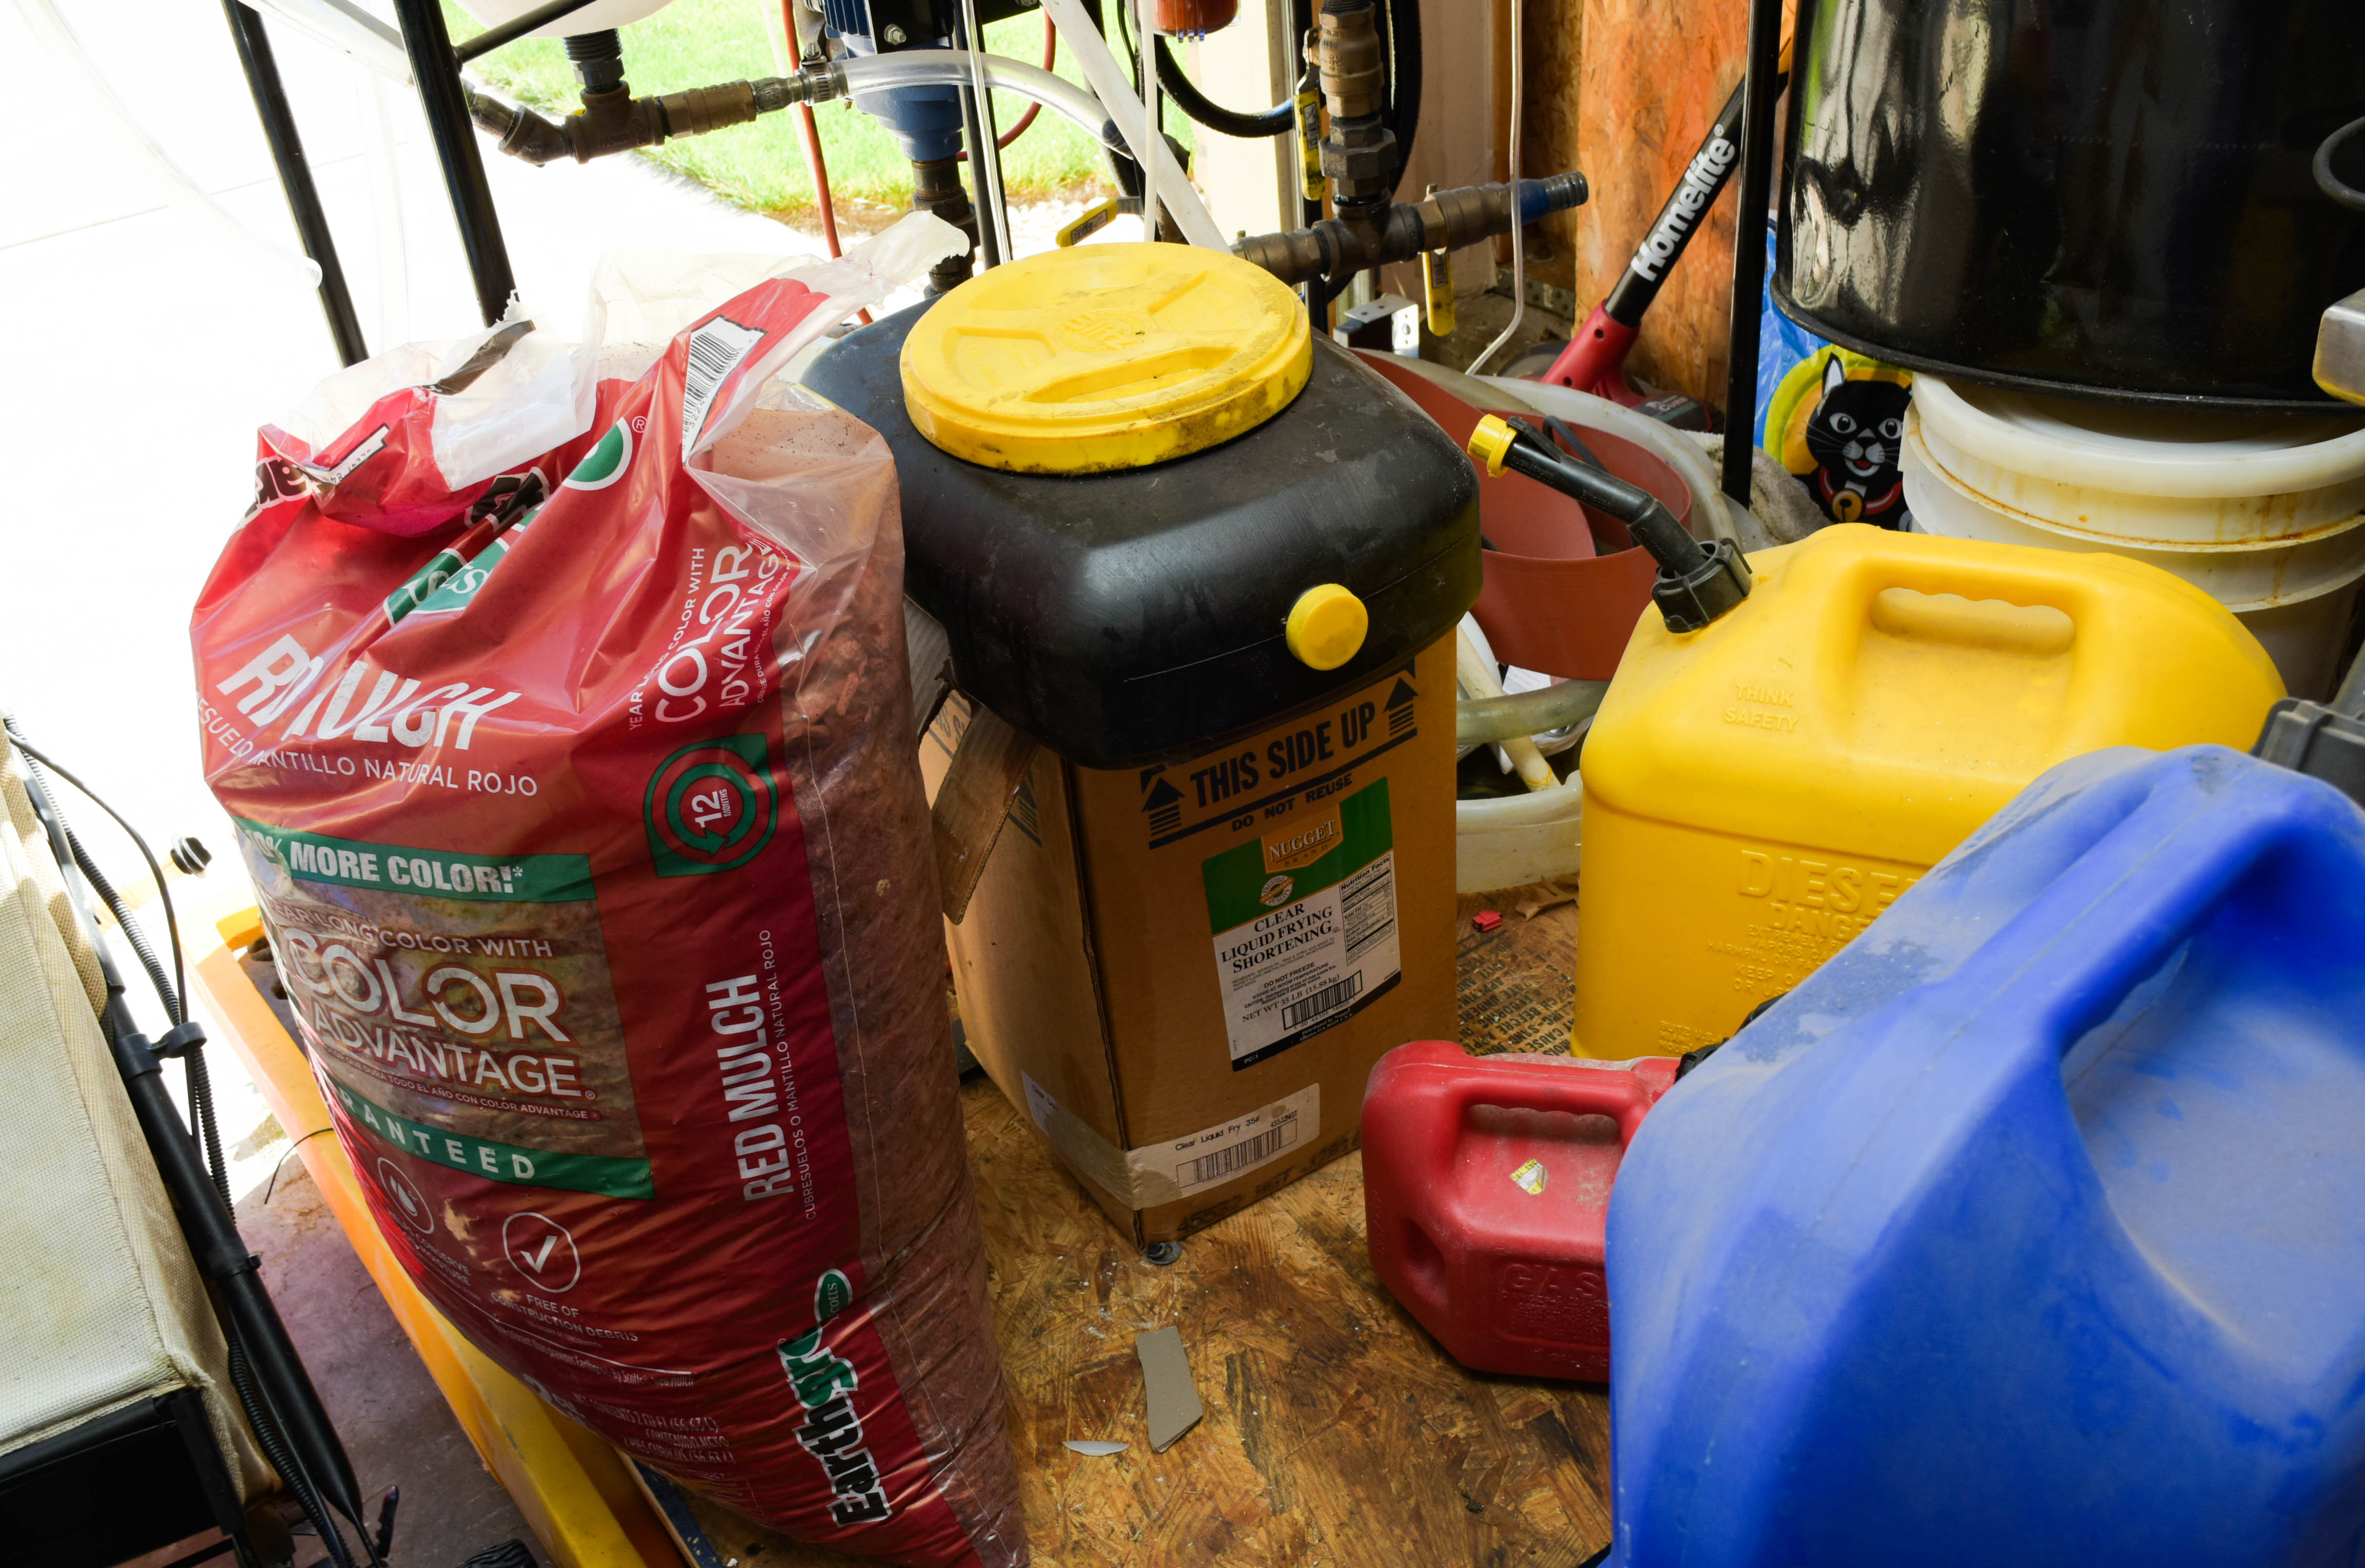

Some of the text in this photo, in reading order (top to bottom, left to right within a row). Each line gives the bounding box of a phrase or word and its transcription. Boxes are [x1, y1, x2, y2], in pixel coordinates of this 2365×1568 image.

[655, 545, 753, 722] COLOR
[762, 610, 771, 626] AÑO
[629, 548, 706, 731] YEAR LONG COLOR WITH
[1735, 682, 1795, 708] THINK
[1723, 707, 1800, 733] SAFETY
[1190, 701, 1375, 808] THIS SIDE UP
[363, 757, 459, 789] NATURAL
[468, 770, 537, 796] ROJO
[691, 791, 723, 828] 12
[719, 788, 732, 817] MONTHS
[1232, 773, 1353, 832] DO NOT REUSE
[1269, 821, 1335, 861] NUGGET
[1284, 845, 1328, 867] BRAND
[290, 840, 381, 883] MORE
[1341, 869, 1370, 891] Nutrition
[1371, 856, 1390, 872] Facts
[1263, 877, 1286, 894] TRUSTED
[1737, 849, 1919, 918] DIESE
[314, 912, 374, 943] LONG
[380, 930, 471, 955] COLOR
[476, 938, 553, 957] WITH
[1220, 932, 1275, 963] LIQUID
[1277, 906, 1333, 939] FRYING
[1254, 903, 1305, 933] CLEAR
[1747, 924, 1824, 948] EXTREMELY
[1232, 919, 1333, 974] SHORTENING
[1749, 937, 1804, 957] VAPORS
[1773, 953, 1791, 969] OR
[283, 928, 572, 1043] COLOR
[1252, 989, 1269, 1000] STORE
[1277, 978, 1293, 989] ROOM
[1293, 962, 1329, 982] TEMPERATURE
[1263, 961, 1315, 989] DO NOT FREEZE
[1732, 977, 1755, 994] OR
[1735, 963, 1776, 982] KEEP
[1241, 973, 1340, 1024] NET WT 35 LB (15.88 kg)
[1525, 1028, 1564, 1053] CAUSE
[759, 929, 817, 1220] CUBRESUELOS O MANTILLO NATURAL ROJO
[1244, 1054, 1259, 1064] PC-1
[388, 1075, 415, 1090] TODO
[416, 1083, 430, 1094] EL
[431, 1085, 454, 1101] AÑO
[455, 1091, 479, 1106] CON
[480, 1096, 518, 1111] COLOR
[705, 974, 794, 1201] RED MULCH
[1175, 1115, 1261, 1151] Clear Liquid Fry 35#
[1504, 1263, 1602, 1300] GAS
[491, 1291, 584, 1334] CONSTRUCTION
[584, 1326, 639, 1343] DEBRIS
[526, 1293, 580, 1318] FREE OF
